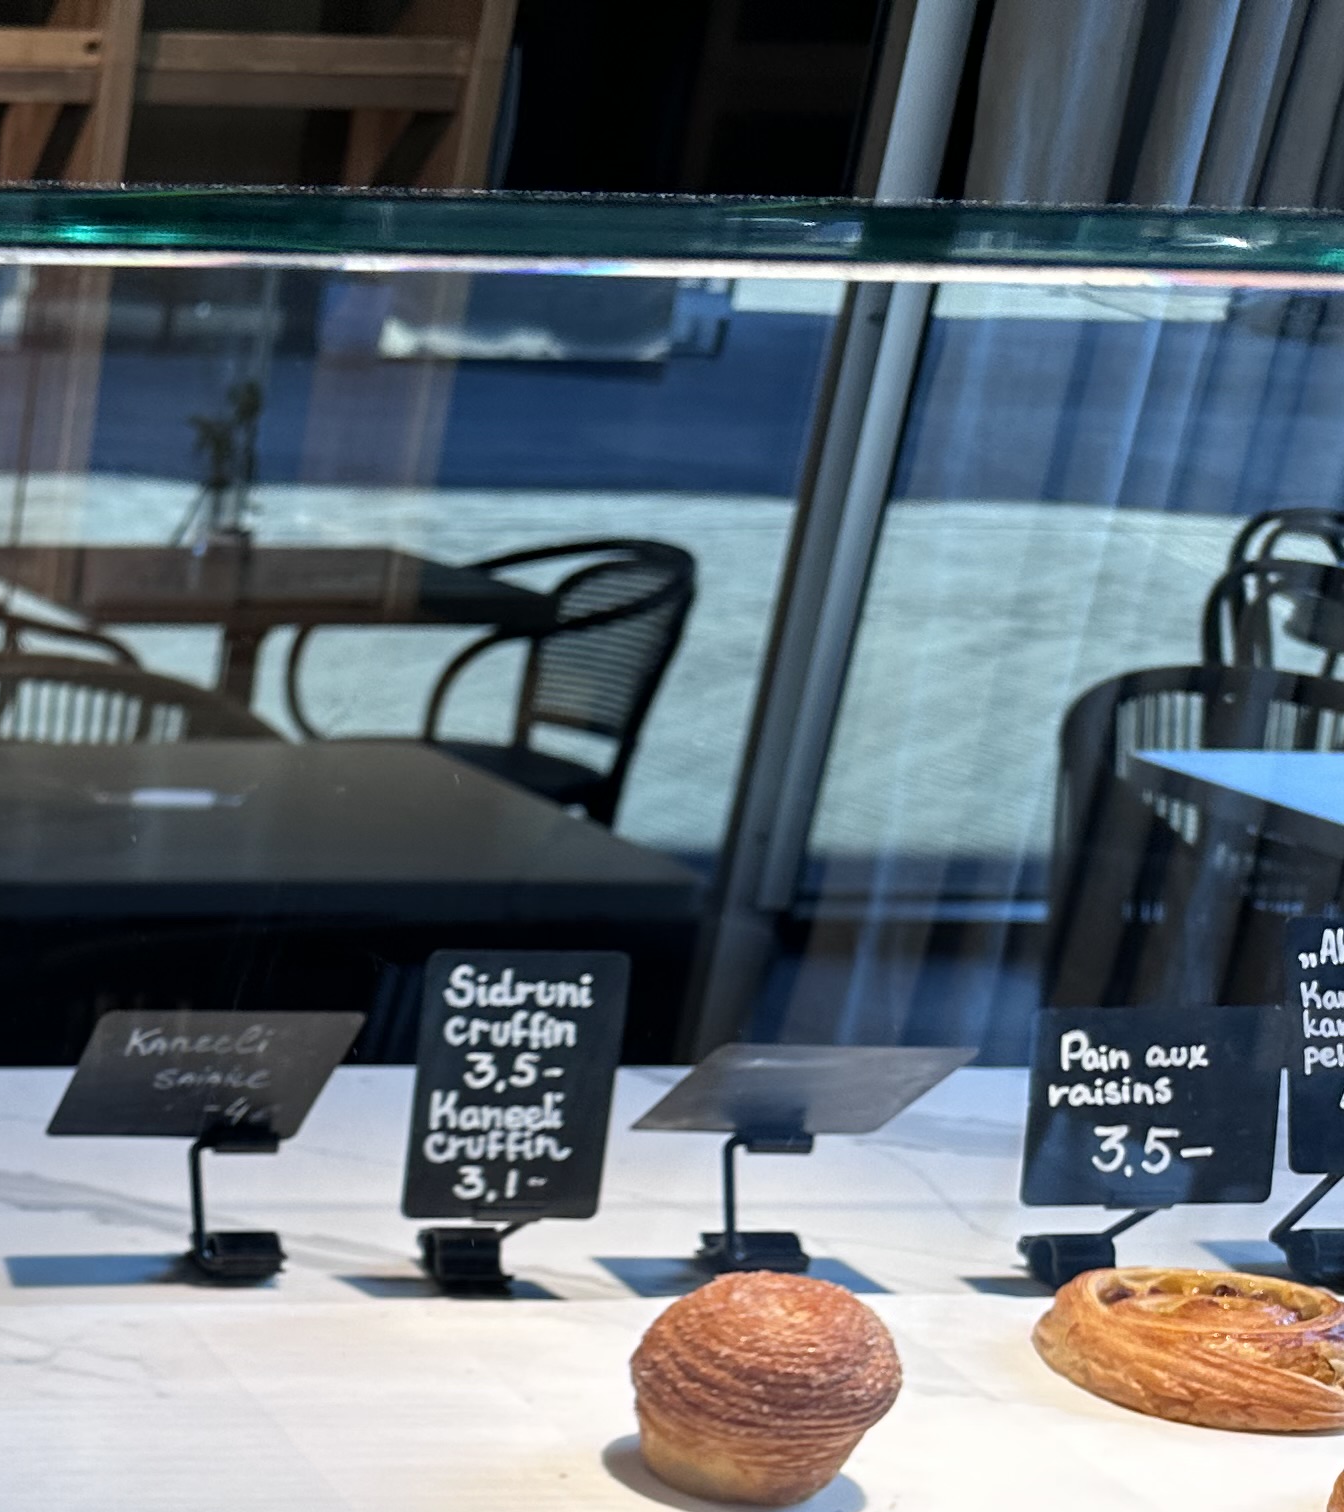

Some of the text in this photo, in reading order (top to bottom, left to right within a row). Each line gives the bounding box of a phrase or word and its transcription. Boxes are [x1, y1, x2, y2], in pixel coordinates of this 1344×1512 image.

[443, 963, 595, 1008] Sidruni
[1061, 1029, 1210, 1071] Pain aux
[1047, 1076, 1175, 1108] raisins
[1090, 1123, 1215, 1178] 3.5-
